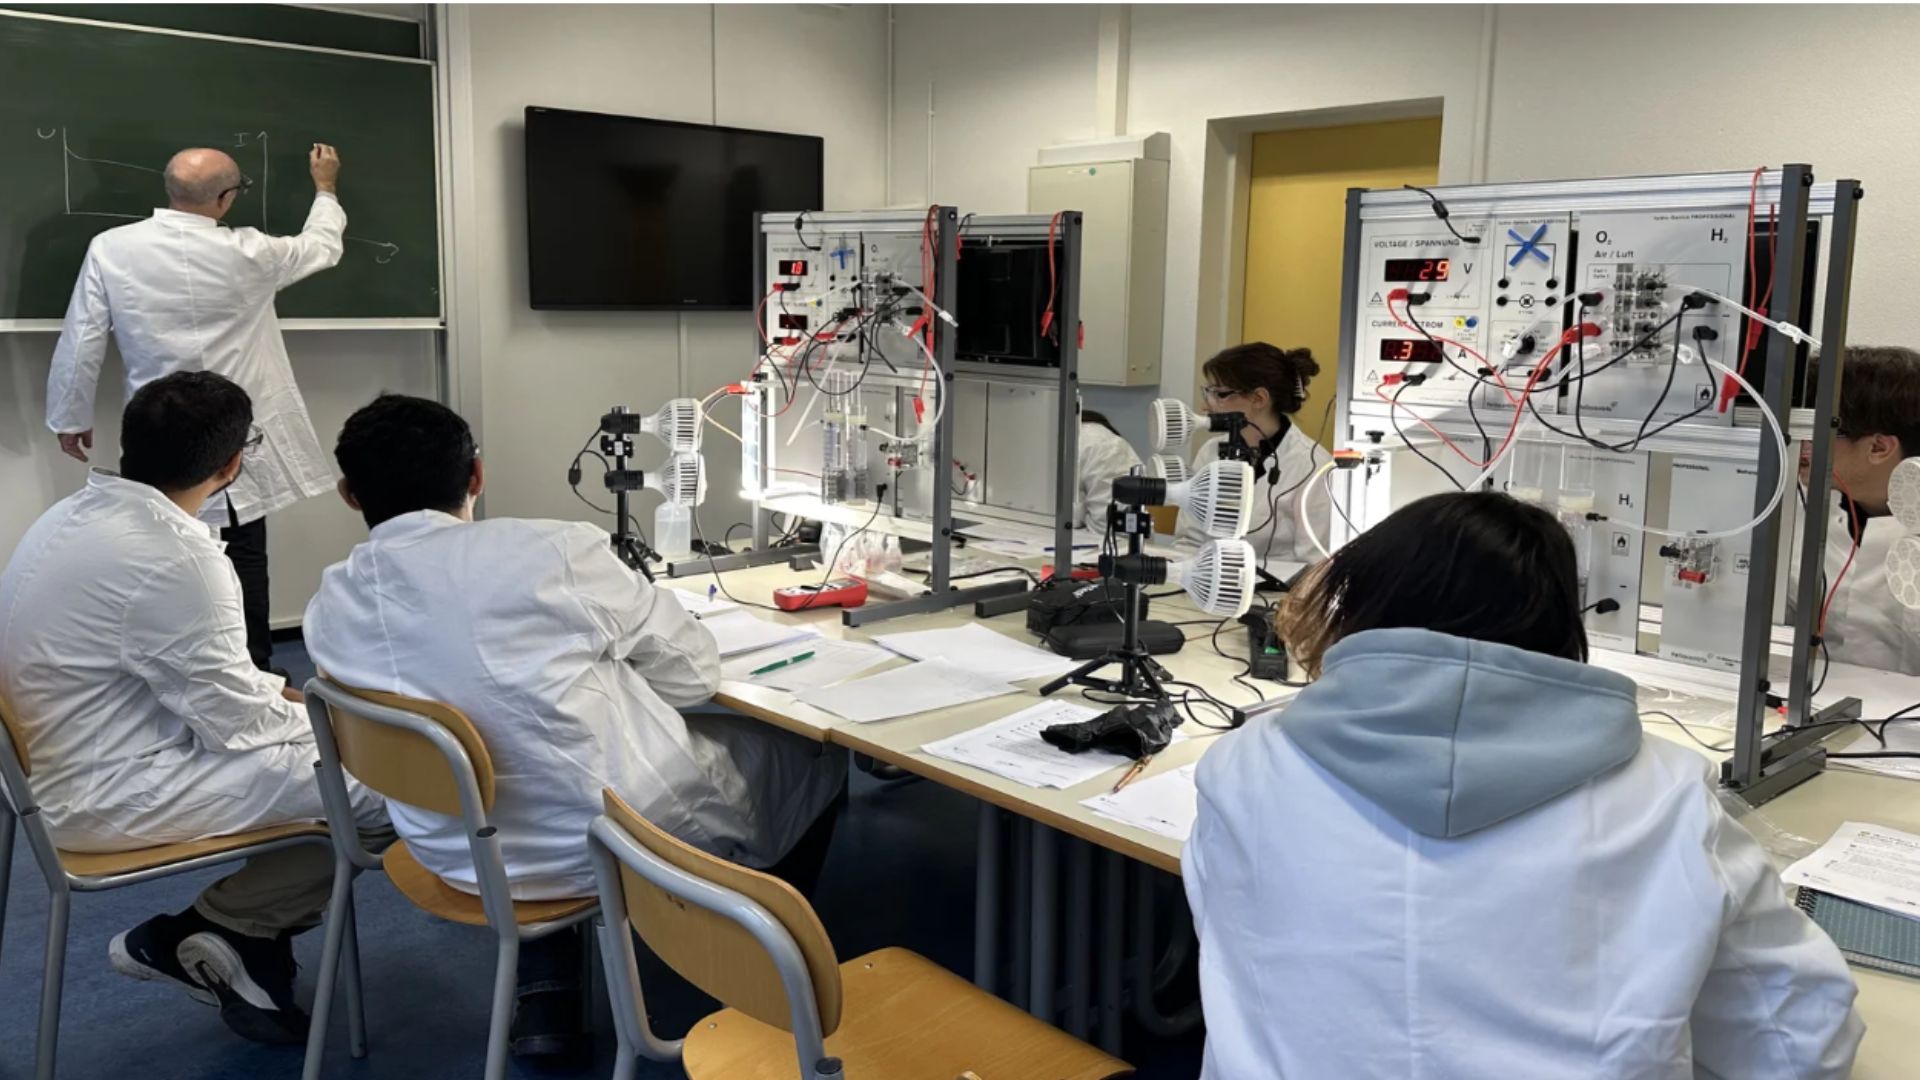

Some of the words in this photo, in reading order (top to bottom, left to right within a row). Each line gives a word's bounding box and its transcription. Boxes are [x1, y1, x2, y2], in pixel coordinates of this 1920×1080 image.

[1373, 240, 1408, 249] VOLTAGE
[1414, 238, 1461, 248] SPANNUNG
[1616, 249, 1634, 259] Luft
[1463, 262, 1473, 275] V
